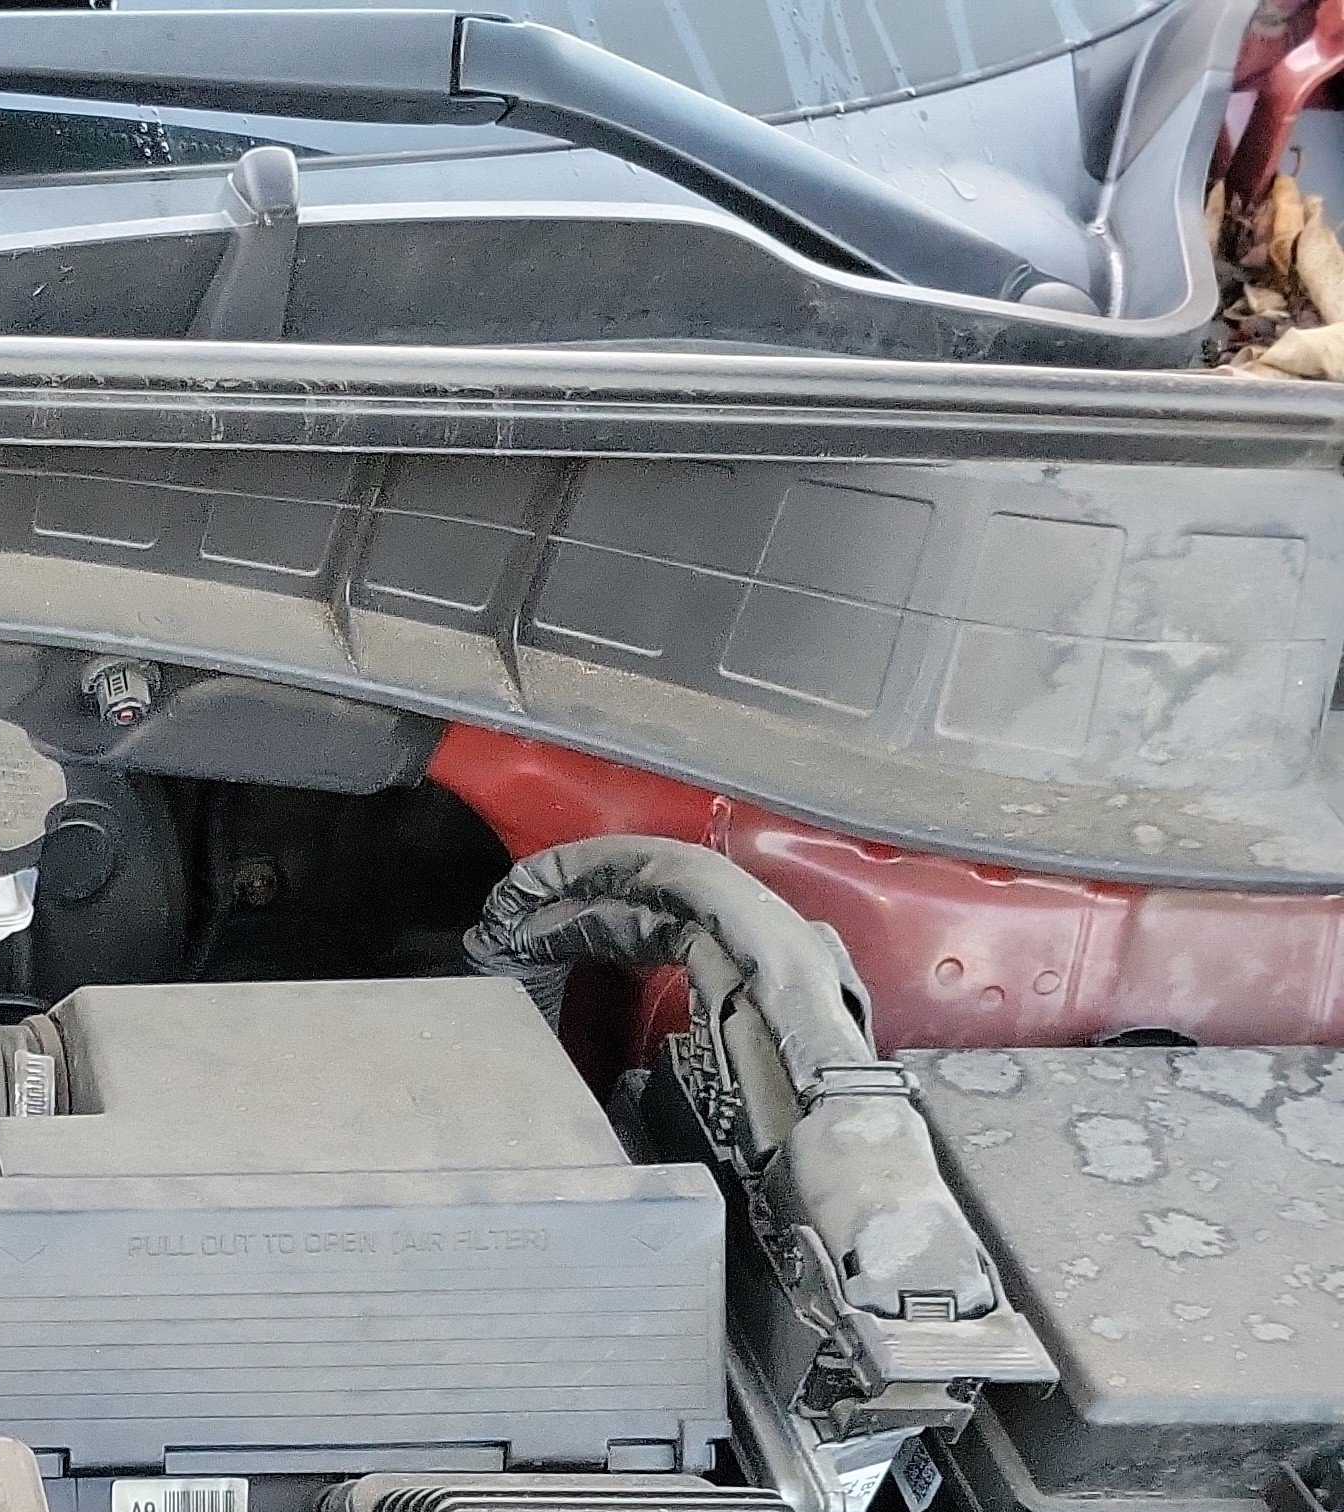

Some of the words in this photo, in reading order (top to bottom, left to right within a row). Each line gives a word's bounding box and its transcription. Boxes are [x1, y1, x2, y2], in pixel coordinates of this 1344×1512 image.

[127, 1235, 194, 1257] PULL
[201, 1233, 256, 1256] OUT
[263, 1232, 295, 1255] TO
[304, 1231, 376, 1254] OPEN
